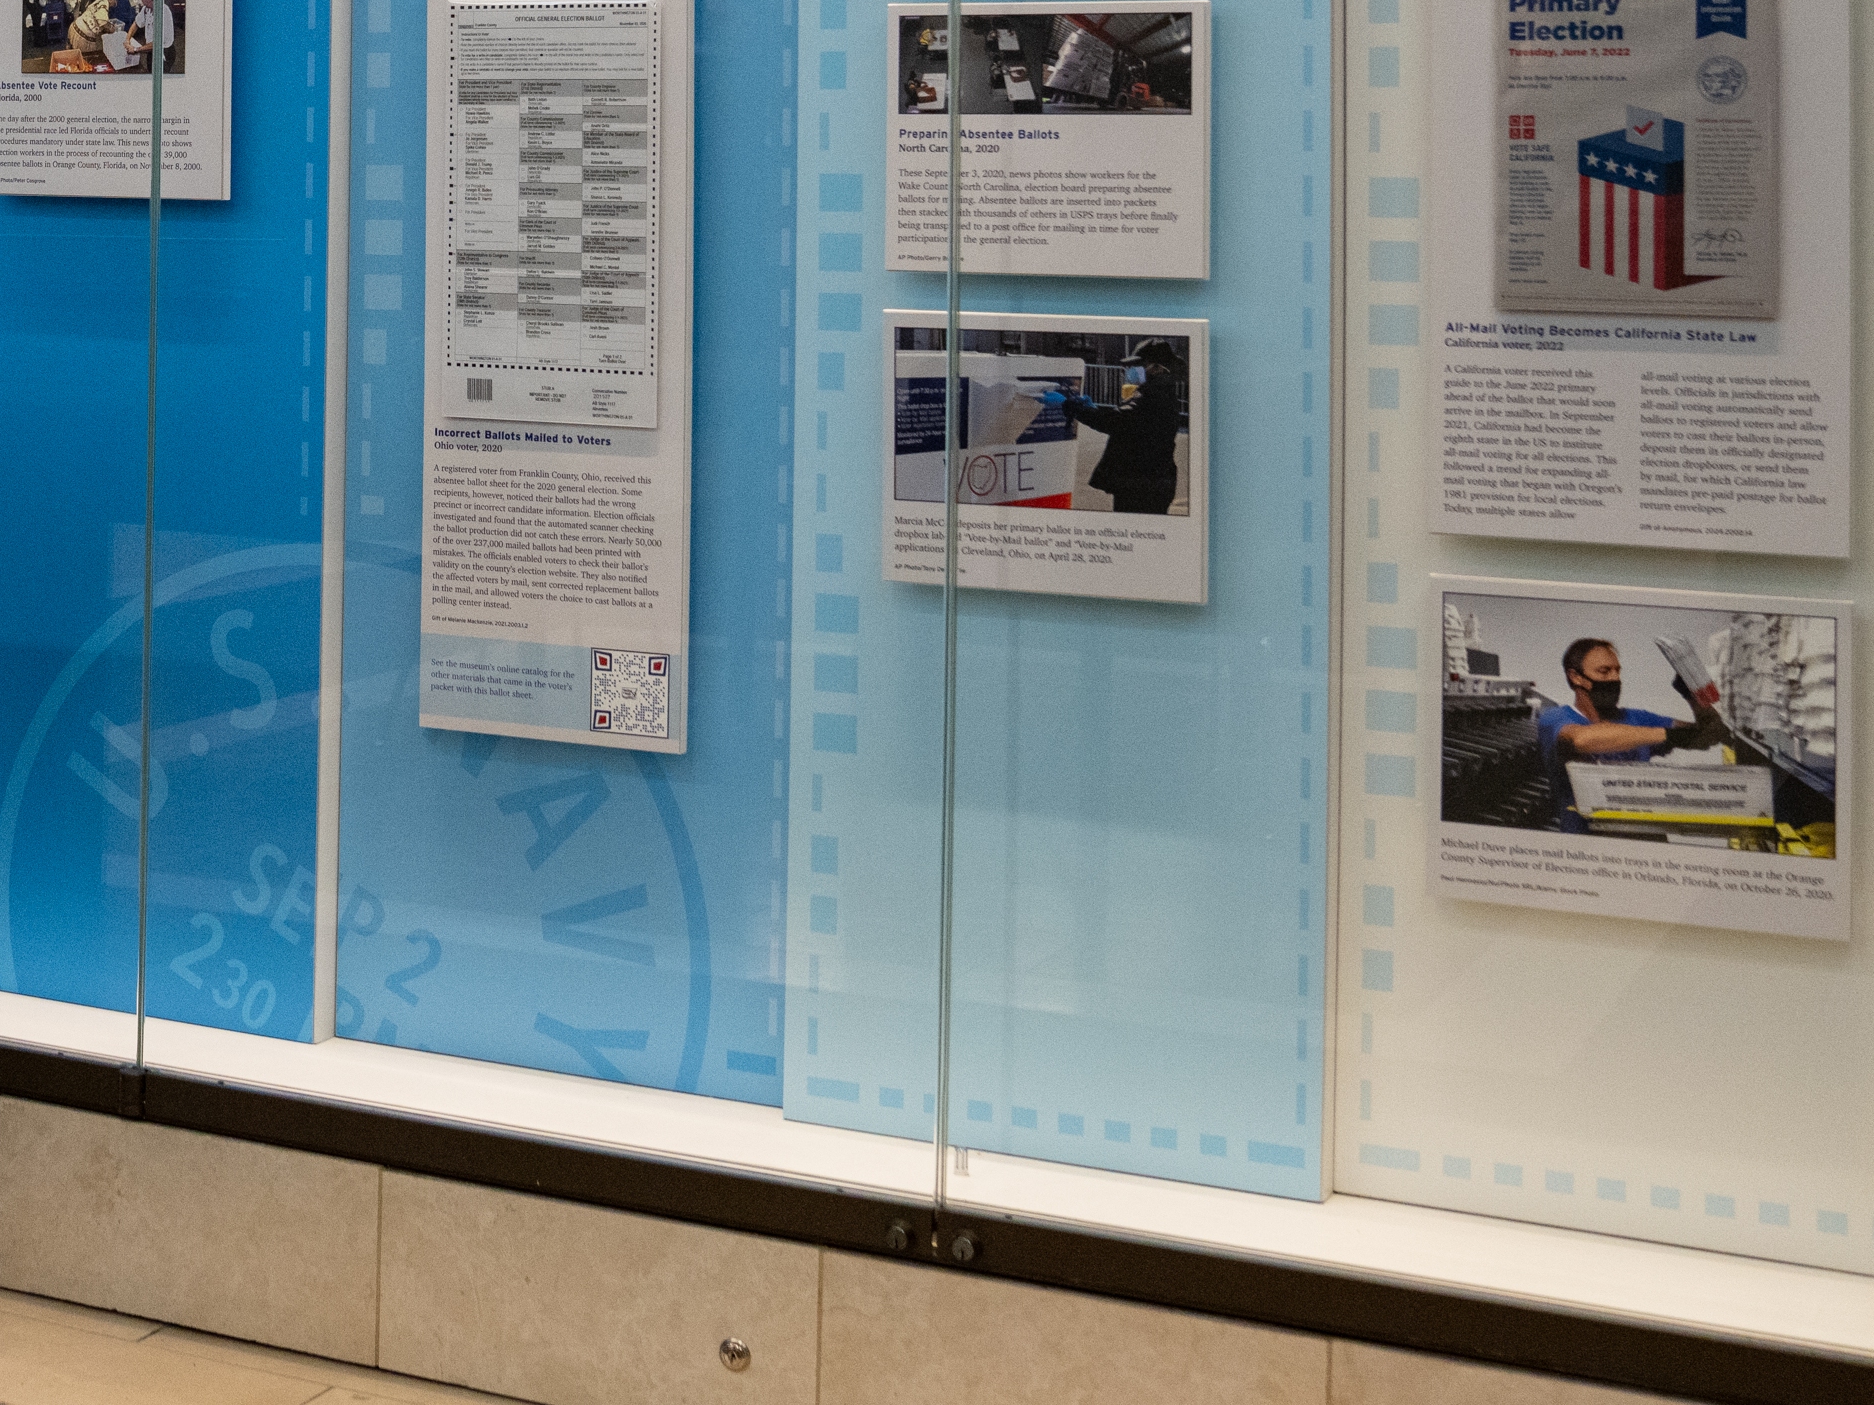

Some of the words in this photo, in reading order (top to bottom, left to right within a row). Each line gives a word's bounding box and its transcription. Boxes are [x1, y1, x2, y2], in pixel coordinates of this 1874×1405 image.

[1508, 21, 1624, 41] Election
[1508, 48, 1556, 57] Tuesday,
[1560, 48, 1587, 56] June
[1602, 48, 1631, 56] 2022
[38, 82, 58, 90] Vote
[61, 82, 96, 90] Recount
[899, 129, 955, 141] Preparin
[960, 129, 1014, 139] Absentee
[1018, 129, 1060, 139] Ballots
[1445, 323, 1497, 334] All-Mail
[1502, 324, 1544, 338] Voting
[1549, 325, 1609, 338] Becomes
[1614, 328, 1681, 341] California
[1687, 330, 1724, 342] State
[1729, 332, 1756, 343] Law
[435, 428, 480, 440] Incorrect
[485, 429, 521, 442] Ballots
[525, 432, 558, 443] Mailed
[562, 434, 572, 444] to
[577, 435, 611, 446] Voters
[434, 442, 456, 450] Ohio
[458, 443, 479, 453] voter,
[482, 444, 502, 453] 2020
